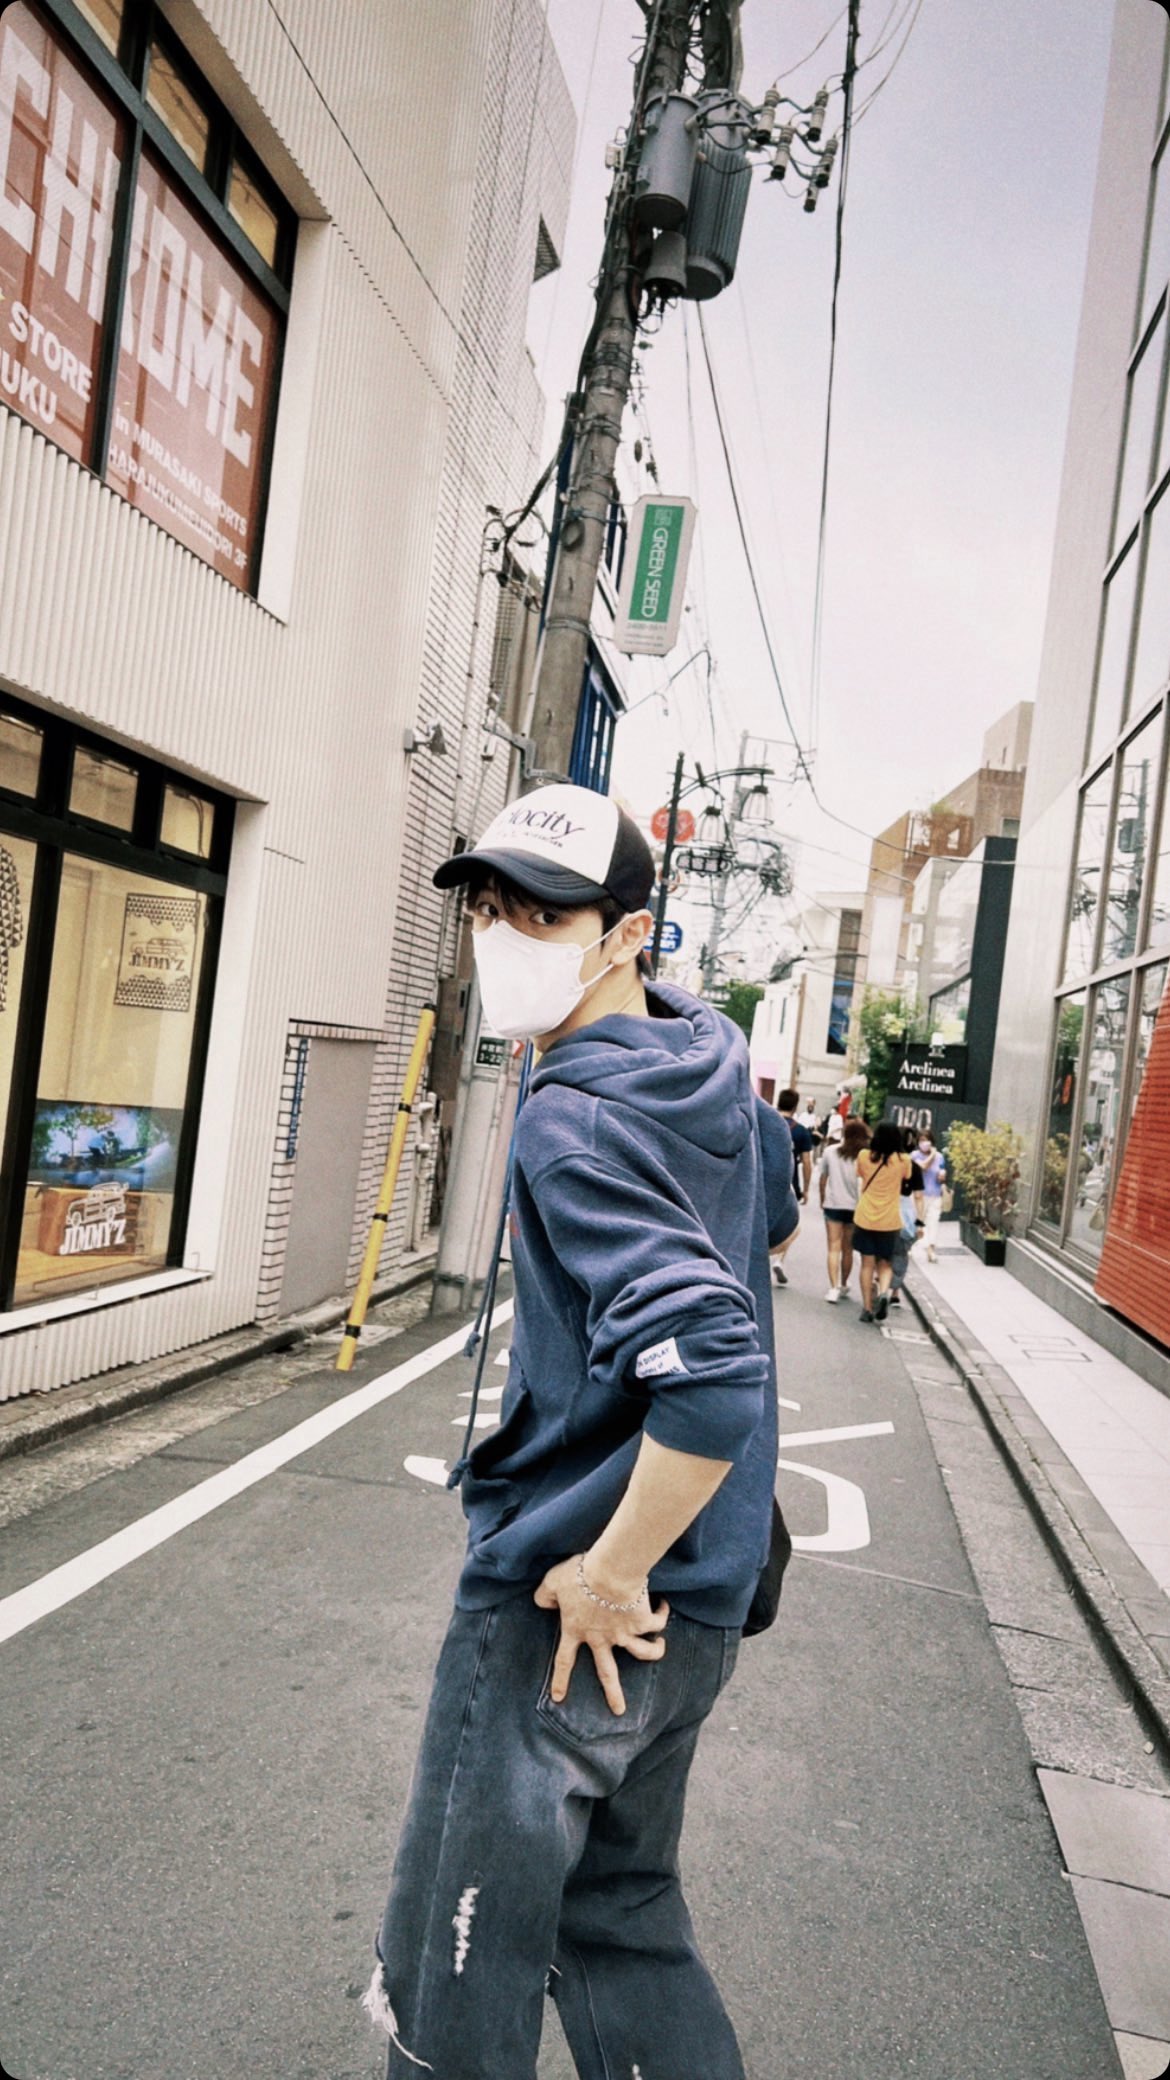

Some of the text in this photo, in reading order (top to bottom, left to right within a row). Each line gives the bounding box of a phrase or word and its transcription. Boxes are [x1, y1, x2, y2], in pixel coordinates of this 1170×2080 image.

[8, 301, 93, 403] STORE
[0, 348, 57, 425] UKU
[115, 408, 248, 537] in MURASAKI SPORTS
[648, 527, 669, 577] GREEN
[641, 577, 662, 618] SEED
[897, 1075, 954, 1095] Arclinea
[899, 1059, 956, 1078] Arclinea
[59, 1218, 127, 1255] JIMMY'Z
